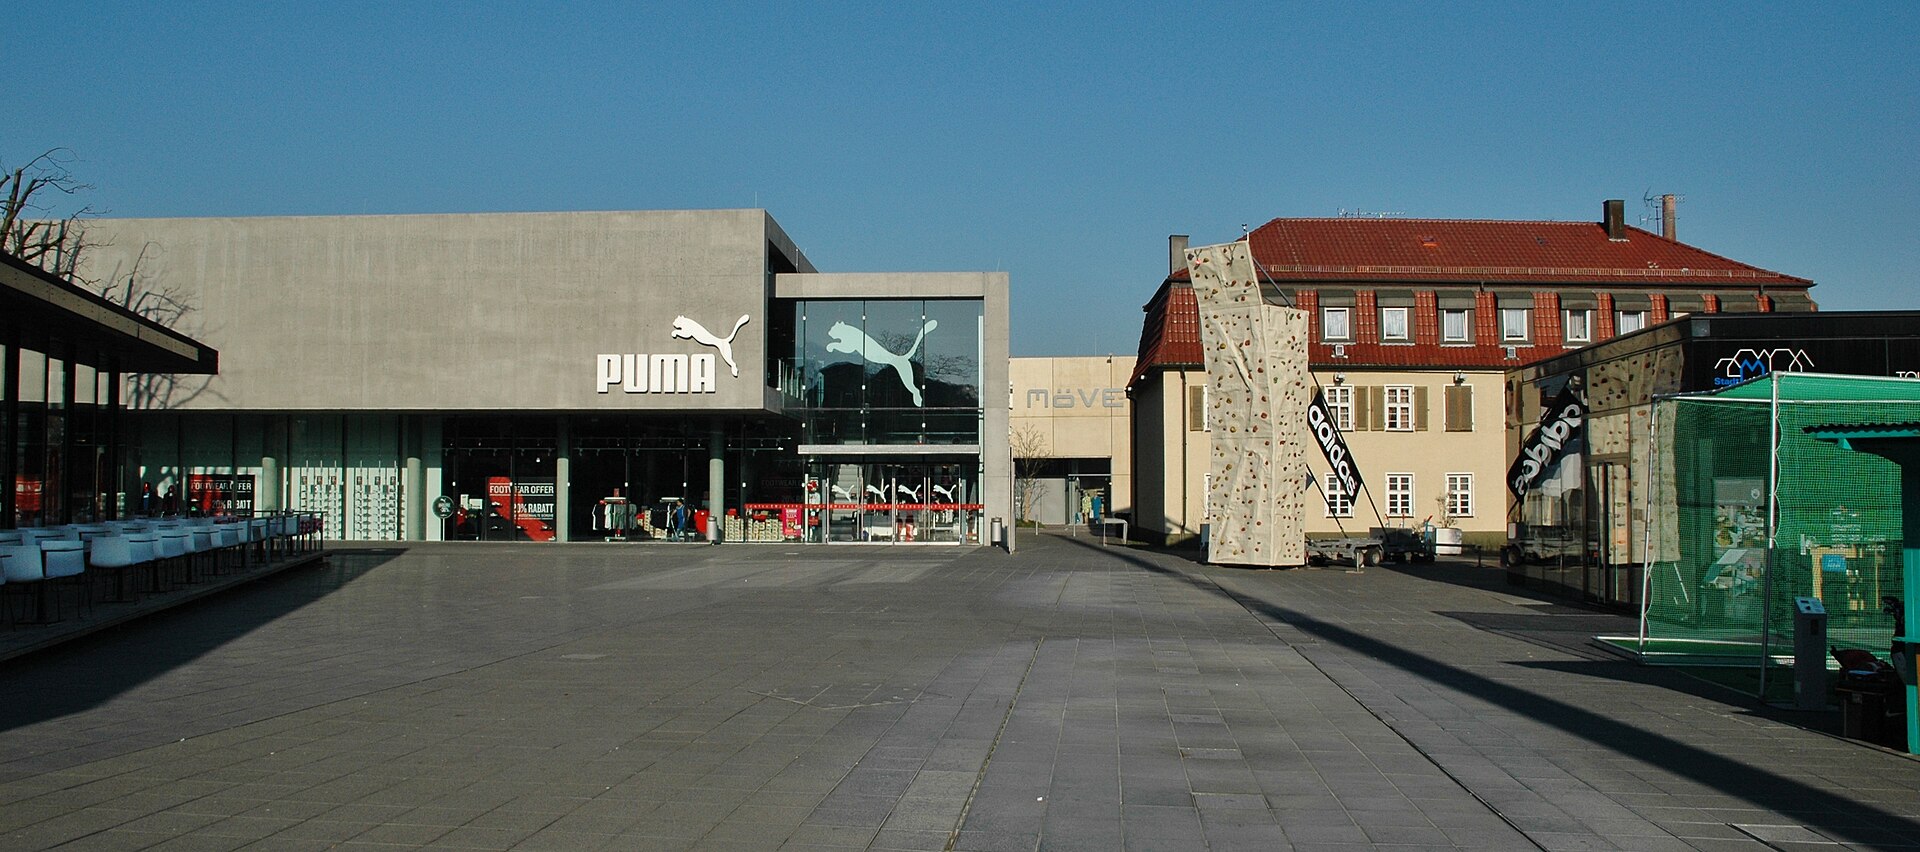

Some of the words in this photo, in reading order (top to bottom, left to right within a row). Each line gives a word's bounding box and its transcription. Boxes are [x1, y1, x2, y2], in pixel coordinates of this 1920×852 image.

[597, 354, 715, 393] PUMA
[1309, 405, 1356, 497] adidas
[229, 482, 252, 490] OFER
[531, 485, 554, 494] OFFER
[227, 500, 252, 509] RBATT
[528, 503, 554, 513] RABATT
